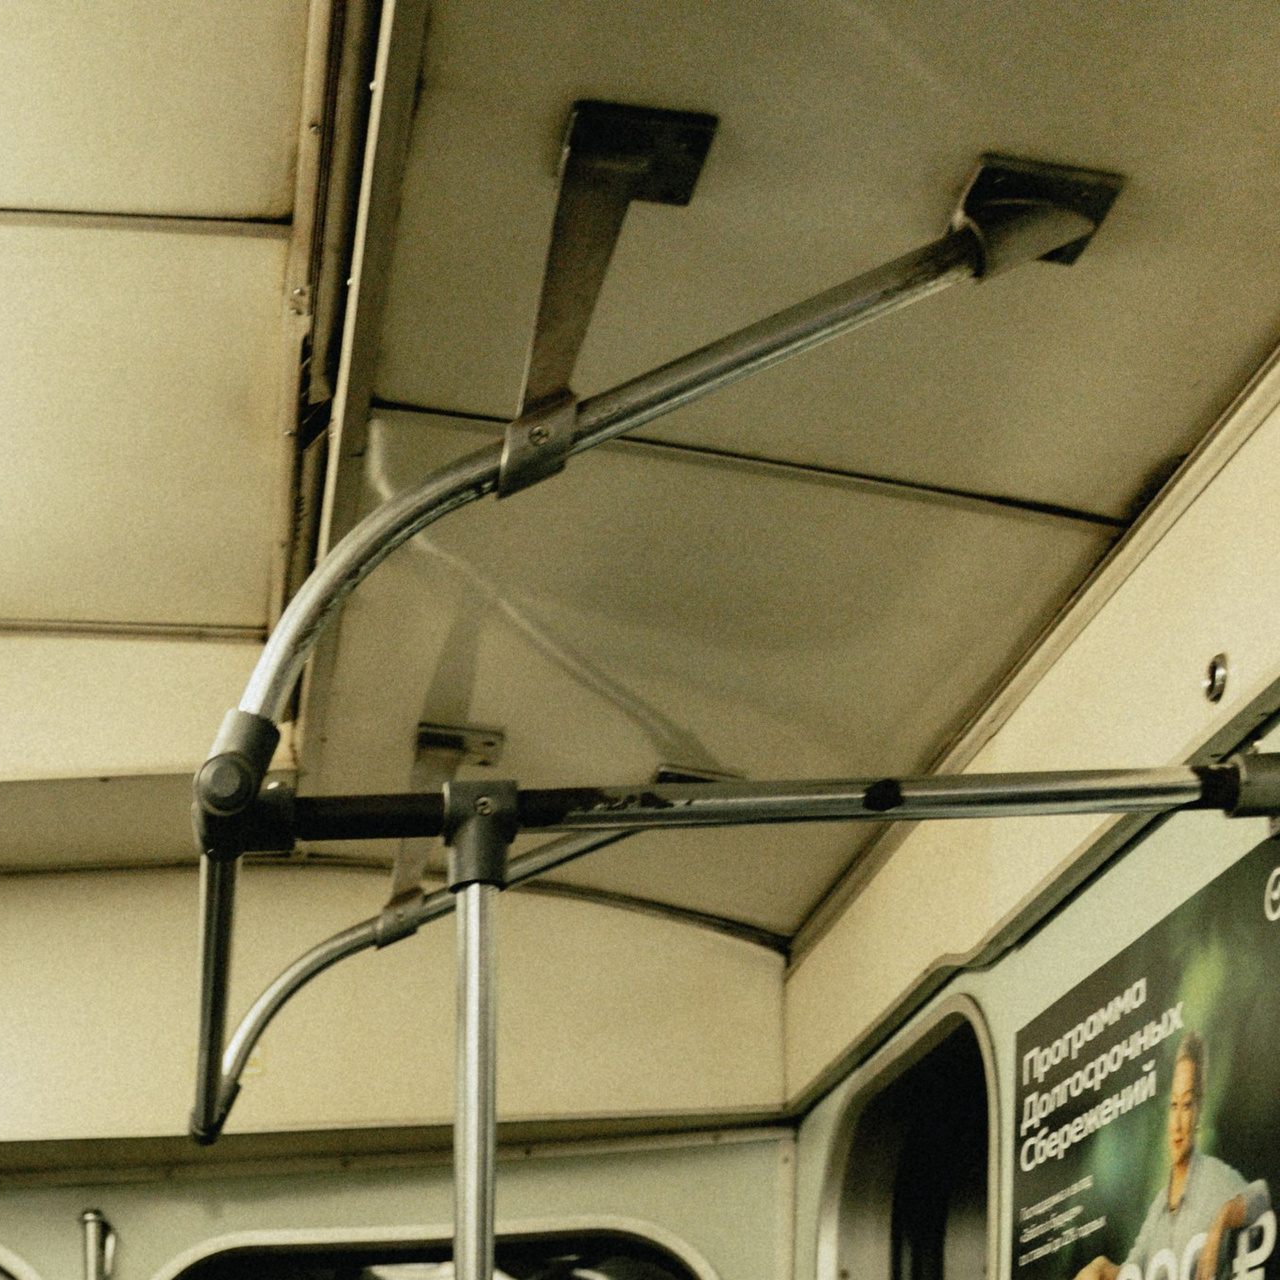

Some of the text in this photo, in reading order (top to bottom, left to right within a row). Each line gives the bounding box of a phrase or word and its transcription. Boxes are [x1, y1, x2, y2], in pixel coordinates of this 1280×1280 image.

[1020, 1001, 1184, 1137] Долгосрочных
[1022, 977, 1147, 1086] Программа
[1020, 1060, 1156, 1172] Сбережений
